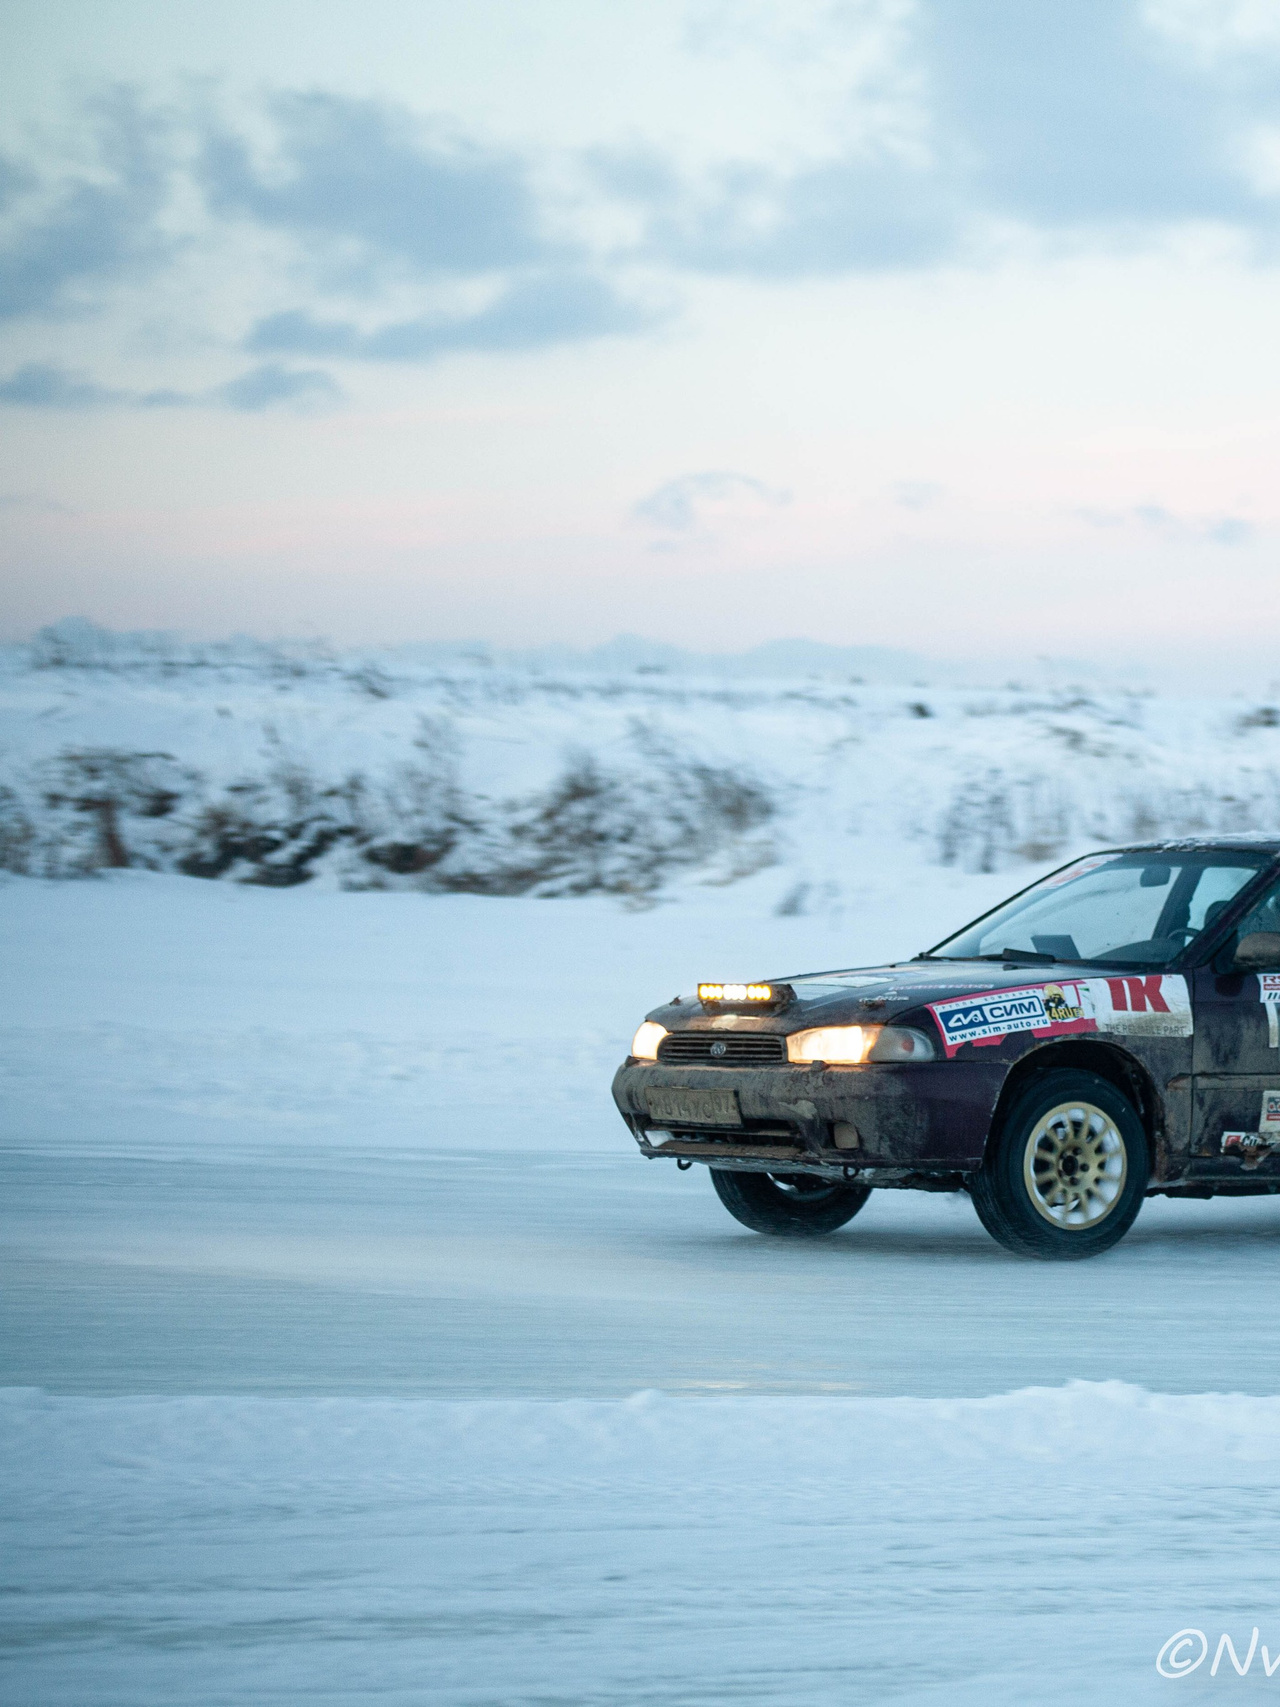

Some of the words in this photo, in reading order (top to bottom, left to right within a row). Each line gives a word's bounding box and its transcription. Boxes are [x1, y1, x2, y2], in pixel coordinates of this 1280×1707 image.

[989, 1001, 1038, 1019] СИМ
[948, 1019, 1048, 1042] www.sim-auto.ru
[1104, 1023, 1120, 1033] THE
[1163, 1025, 1186, 1035] PART
